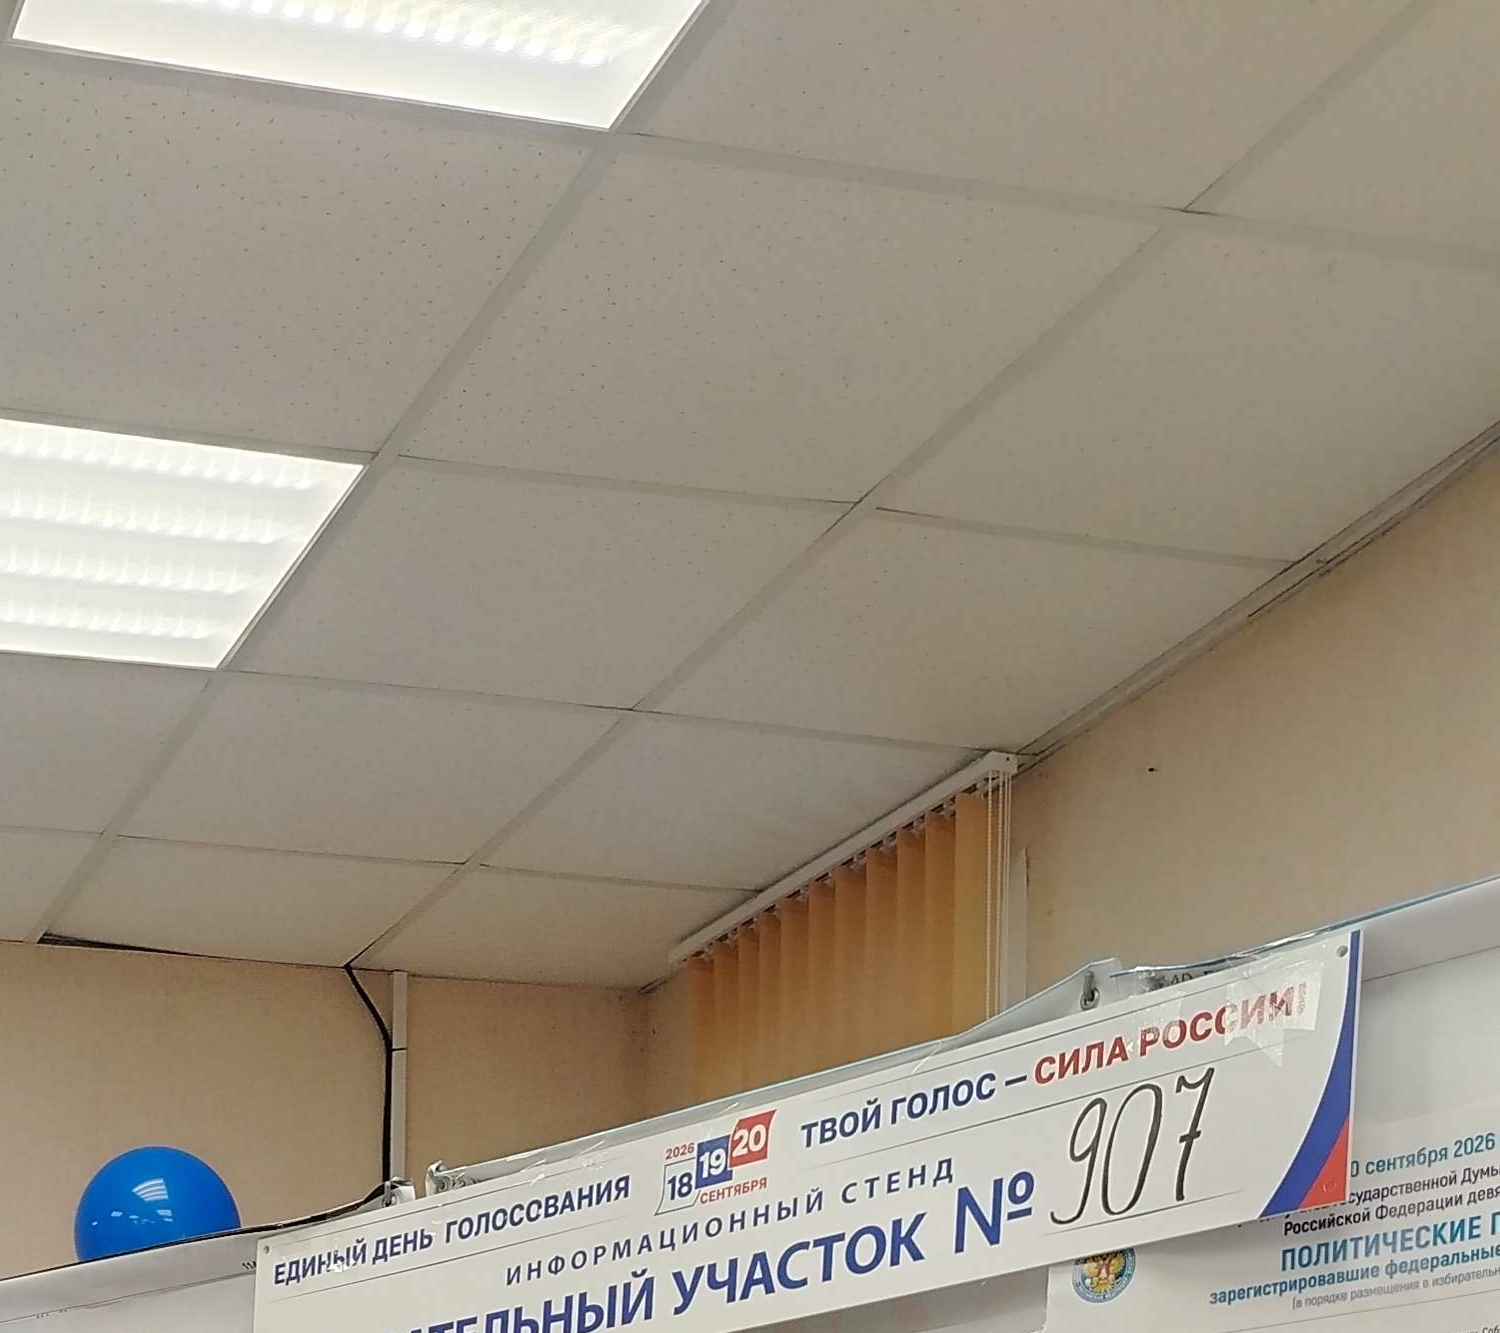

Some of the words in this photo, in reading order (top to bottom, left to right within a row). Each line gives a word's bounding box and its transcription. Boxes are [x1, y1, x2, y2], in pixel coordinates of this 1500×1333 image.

[800, 1097, 882, 1148] ТВОЙ
[890, 1072, 996, 1125] ГОЛОС
[1035, 1036, 1129, 1085] СИЛА
[665, 1142, 695, 1160] 2026
[667, 1172, 693, 1200] 18
[699, 1148, 726, 1179] 19
[732, 1124, 767, 1158] 20
[1050, 1067, 1215, 1225] 907
[1365, 1146, 1448, 1175] сентября
[1453, 1132, 1496, 1158] 2026
[700, 1177, 768, 1204] СЕНТЯБРЯ
[1284, 1207, 1371, 1237] Российской
[1375, 1193, 1463, 1220] Федерации
[1349, 1170, 1457, 1207] сударственной
[274, 1237, 367, 1286] ЕДИНЫЙ
[372, 1228, 433, 1266] ДЕНЬ
[445, 1175, 630, 1244] ГОЛОСОВАНИЯ
[506, 1187, 823, 1286] ИНФОРМАЦИОННЫЙ
[841, 1157, 953, 1204] СТЕНД
[672, 1212, 927, 1316] УЧАСТОК
[954, 1171, 1035, 1254] №
[1281, 1215, 1482, 1272] ПОЛИТИЧЕСКИЕ
[1209, 1265, 1379, 1306] зарегистрировавшие
